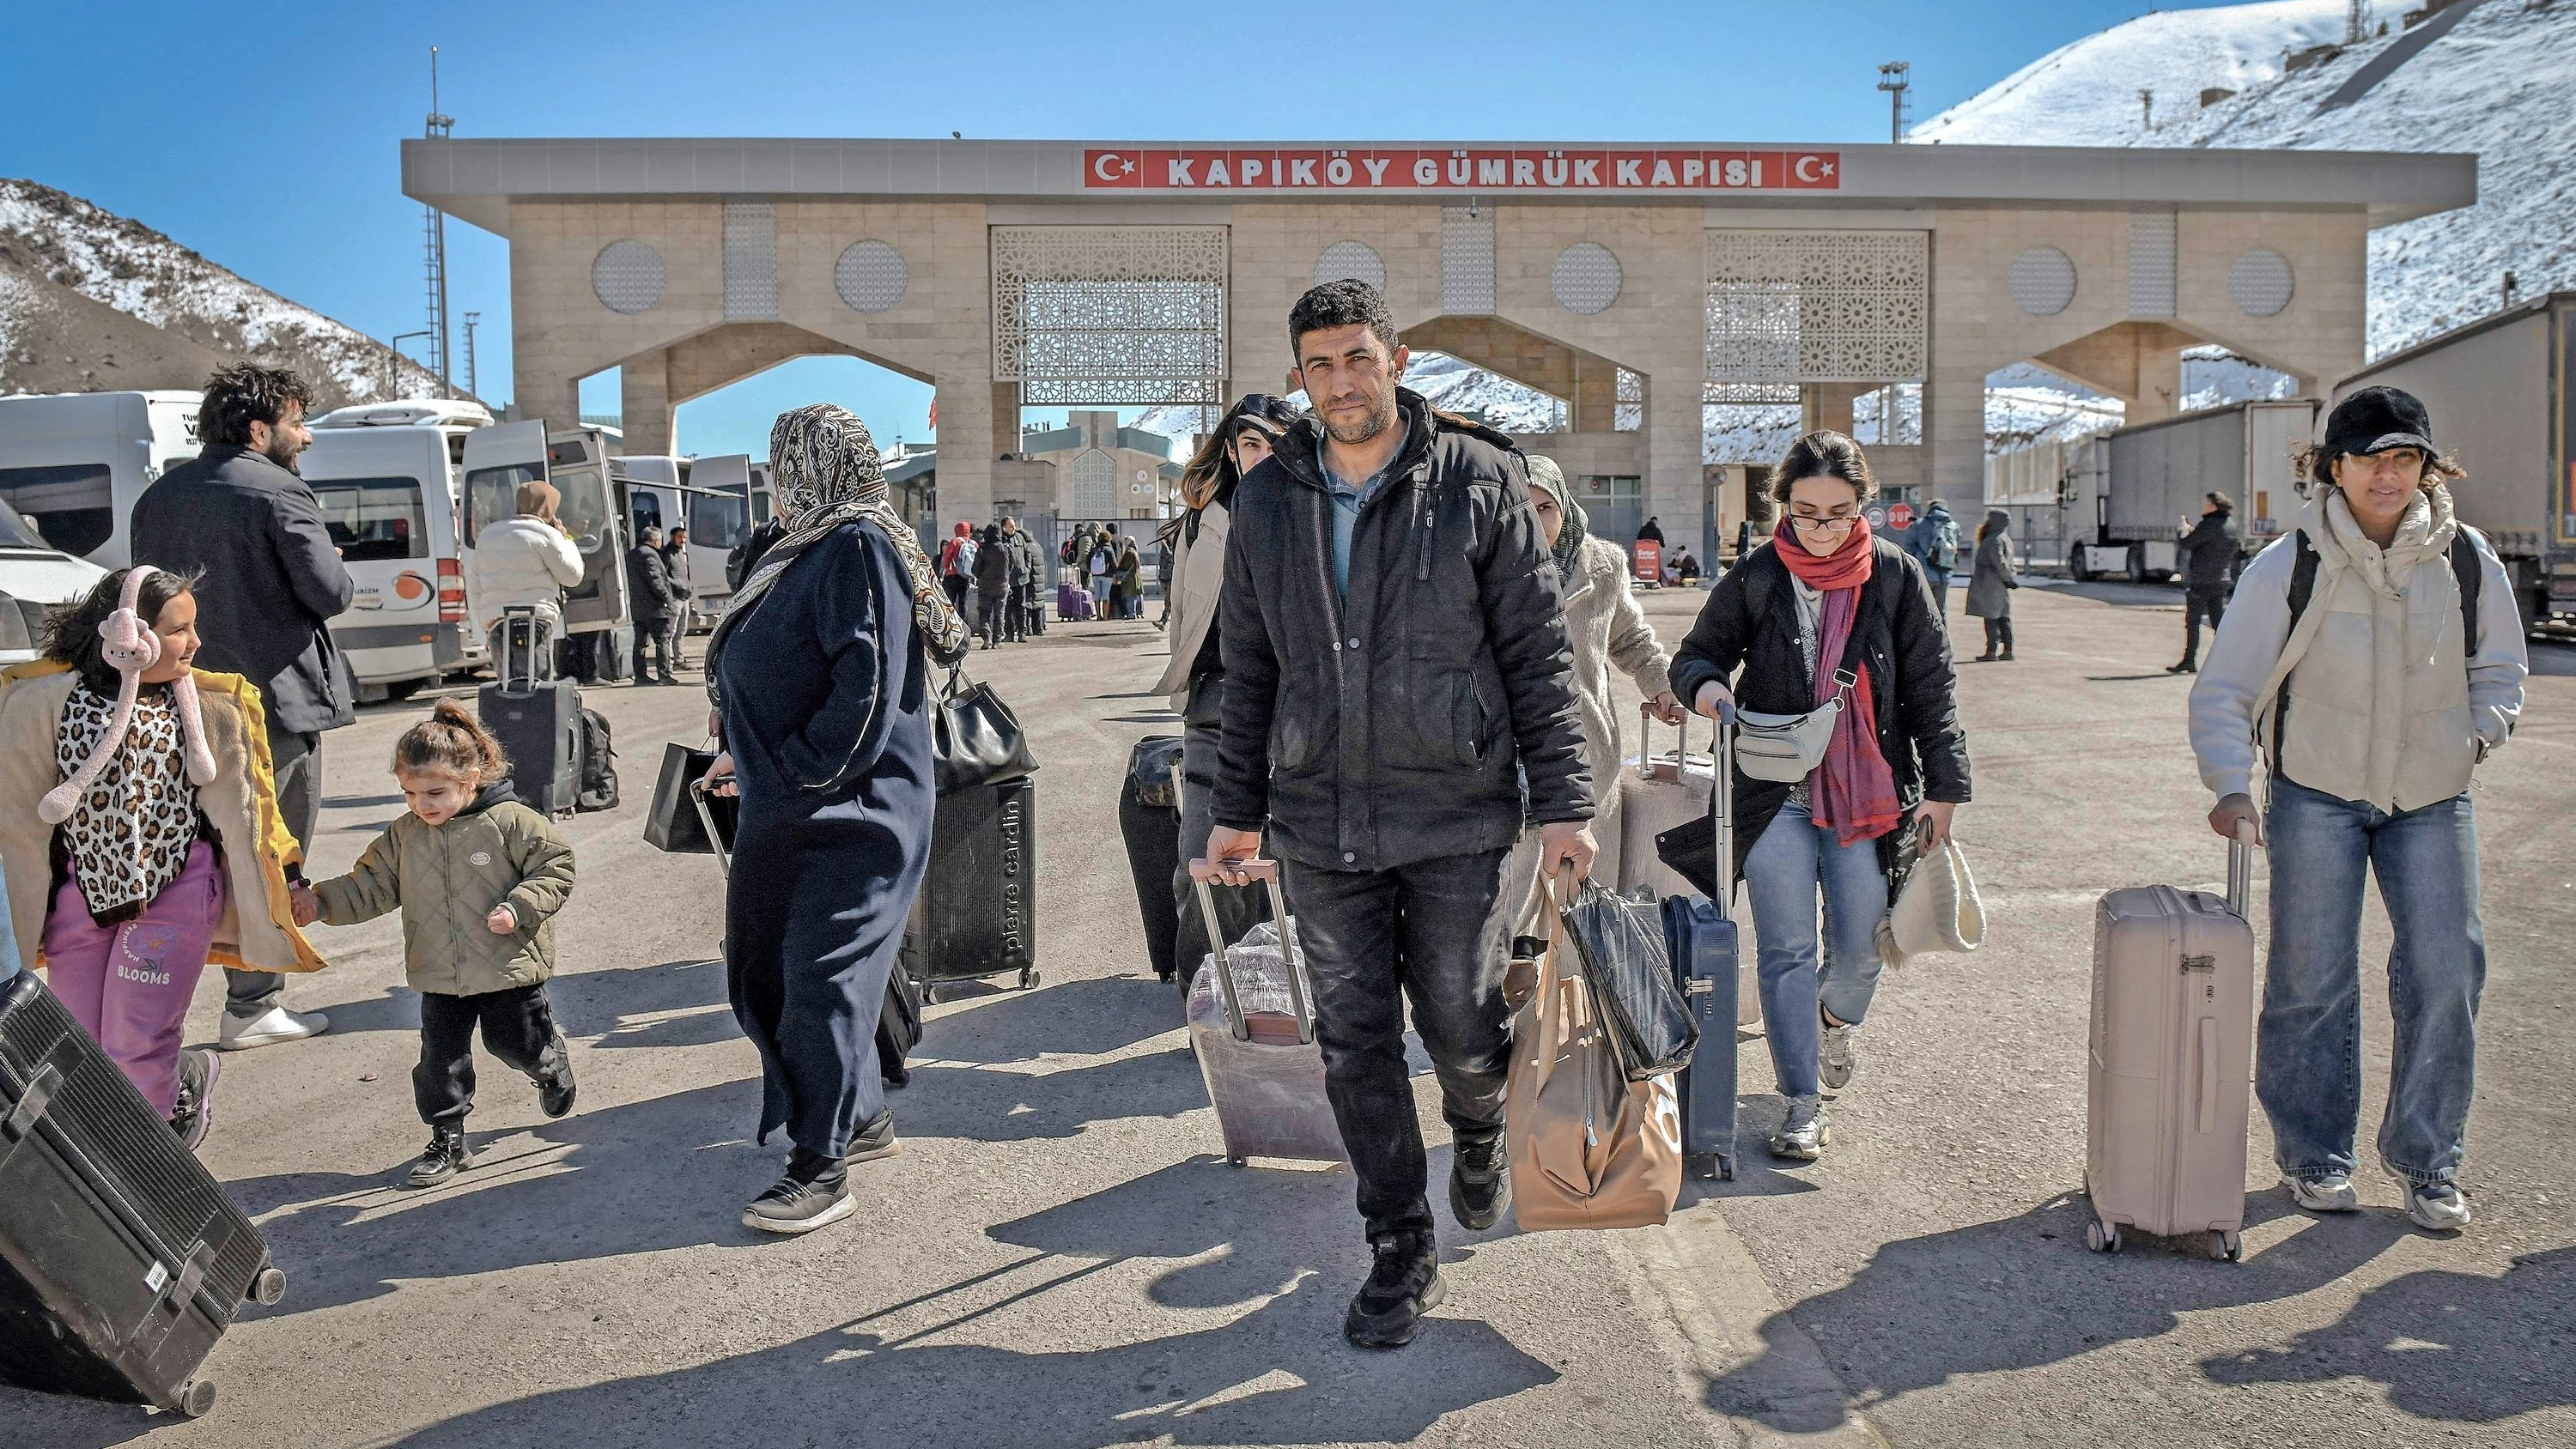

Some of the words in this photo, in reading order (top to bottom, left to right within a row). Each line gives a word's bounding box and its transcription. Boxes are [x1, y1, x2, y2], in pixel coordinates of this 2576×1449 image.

[1168, 149, 1391, 186] KAPIKÖY
[1413, 149, 1601, 186] GÜMRÜK
[1616, 158, 1763, 187] KAPISI
[1001, 800, 1020, 876] cardin
[1001, 882, 1024, 950] pierre
[117, 964, 172, 985] BLOOMS
